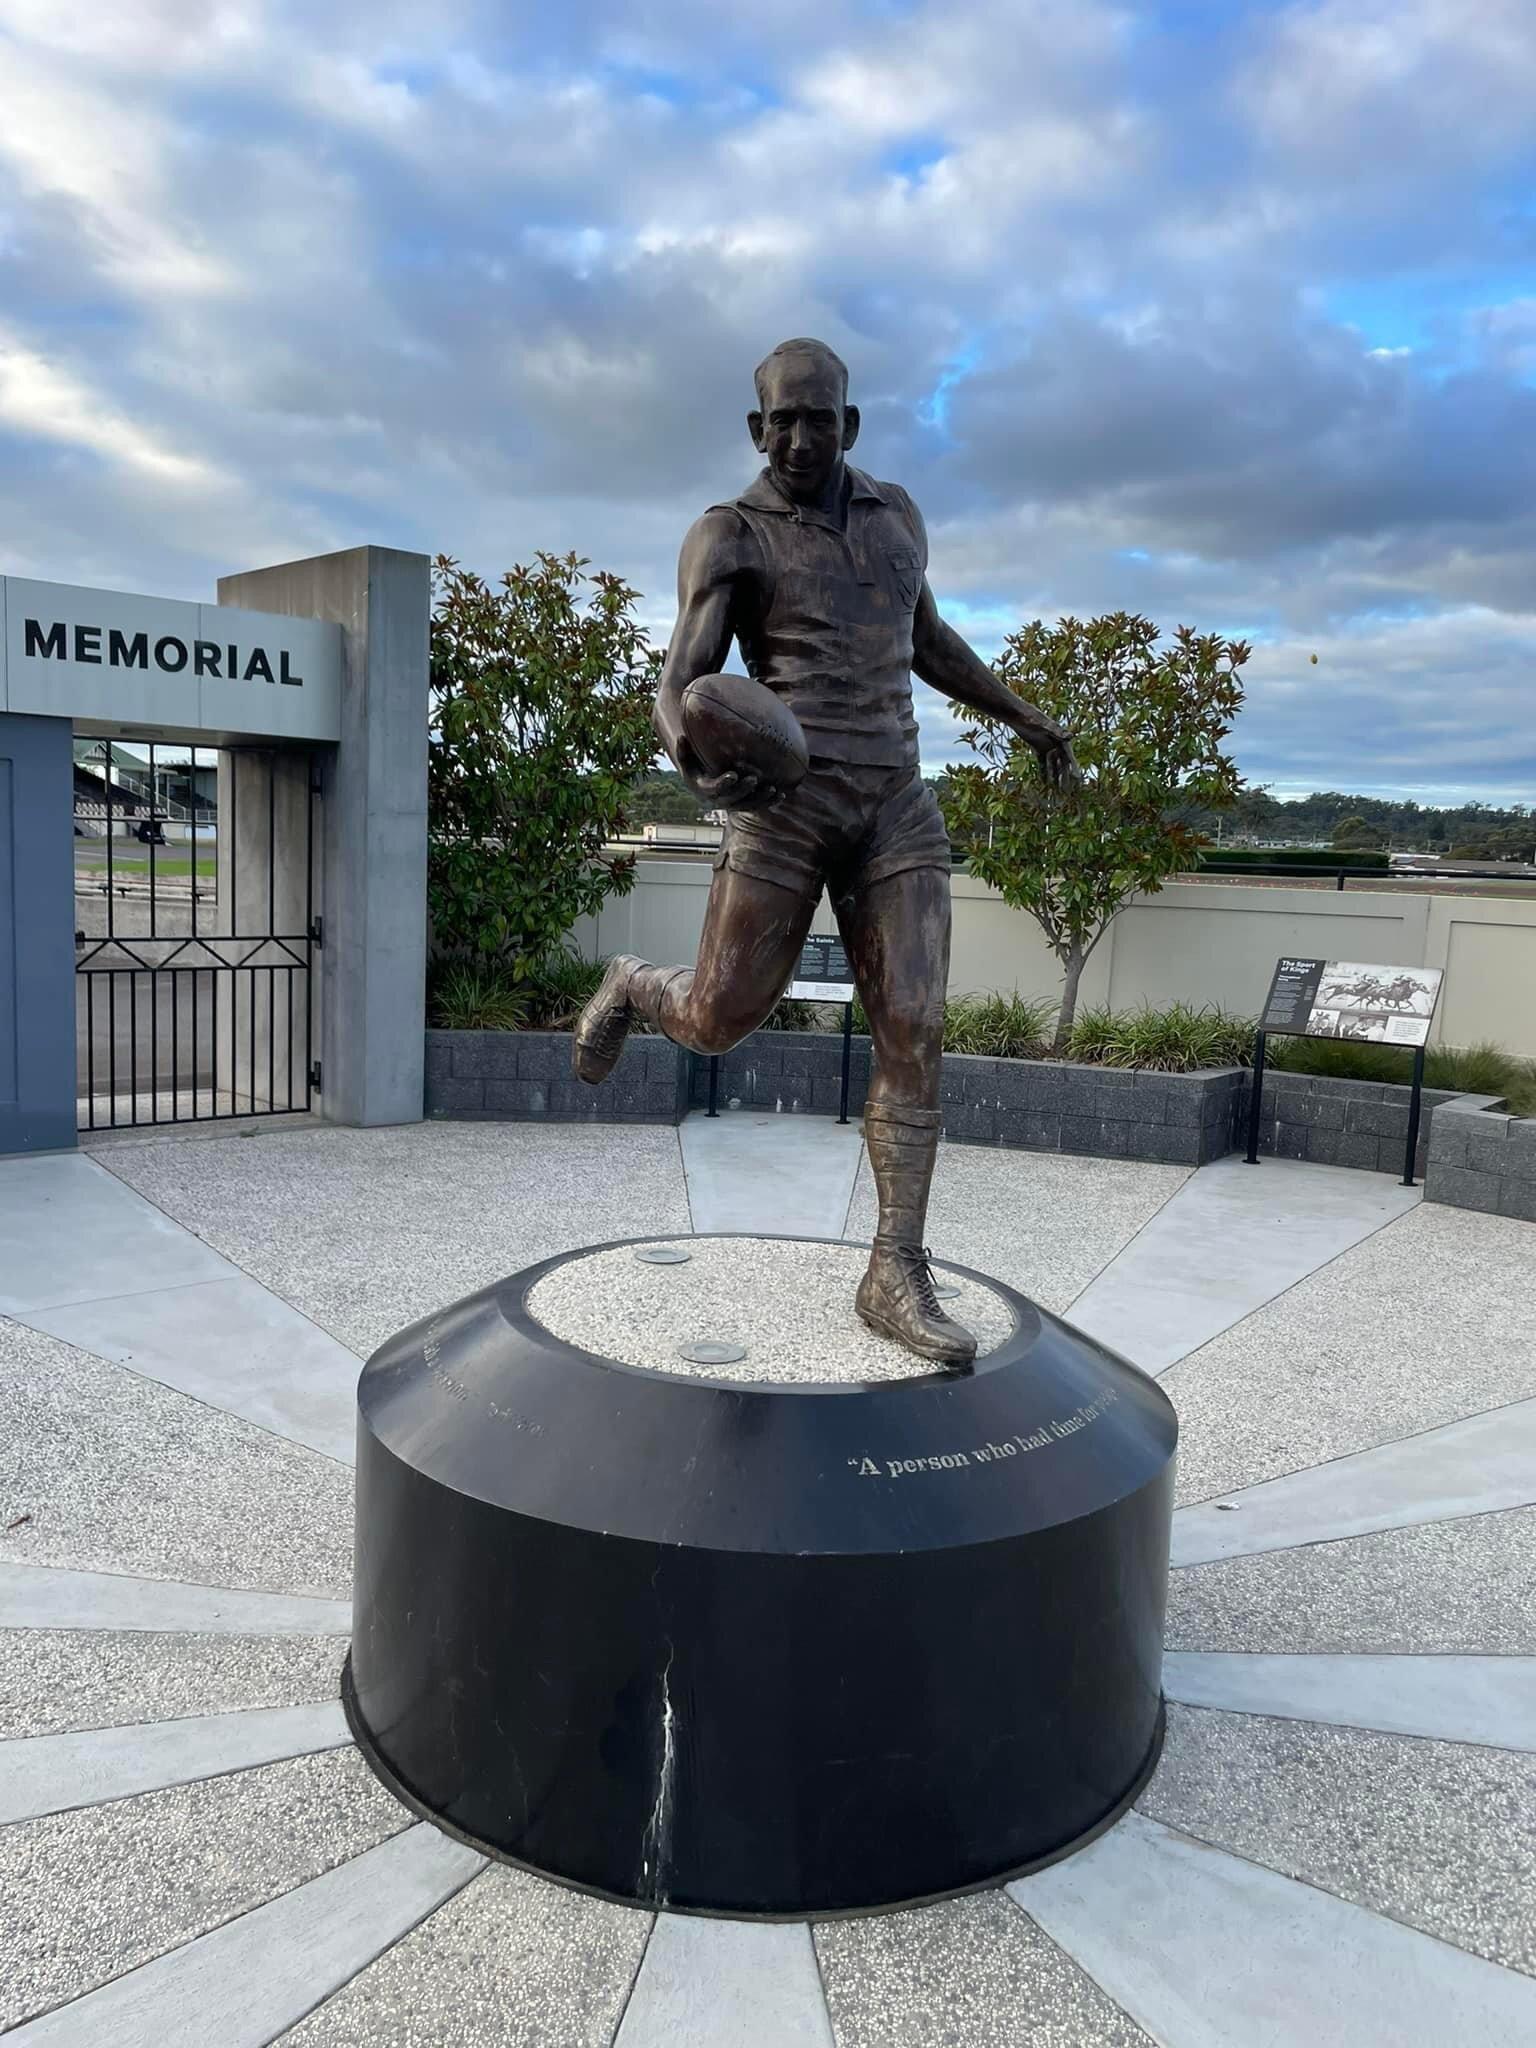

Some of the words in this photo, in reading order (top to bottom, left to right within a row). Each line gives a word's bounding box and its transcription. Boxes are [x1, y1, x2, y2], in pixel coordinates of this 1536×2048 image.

[25, 618, 303, 686] MEMORIAL
[886, 1451, 970, 1477] person
[971, 1442, 1017, 1463] who
[1014, 1428, 1054, 1452] had
[1050, 1417, 1086, 1439] time
[1077, 1405, 1100, 1422] for
